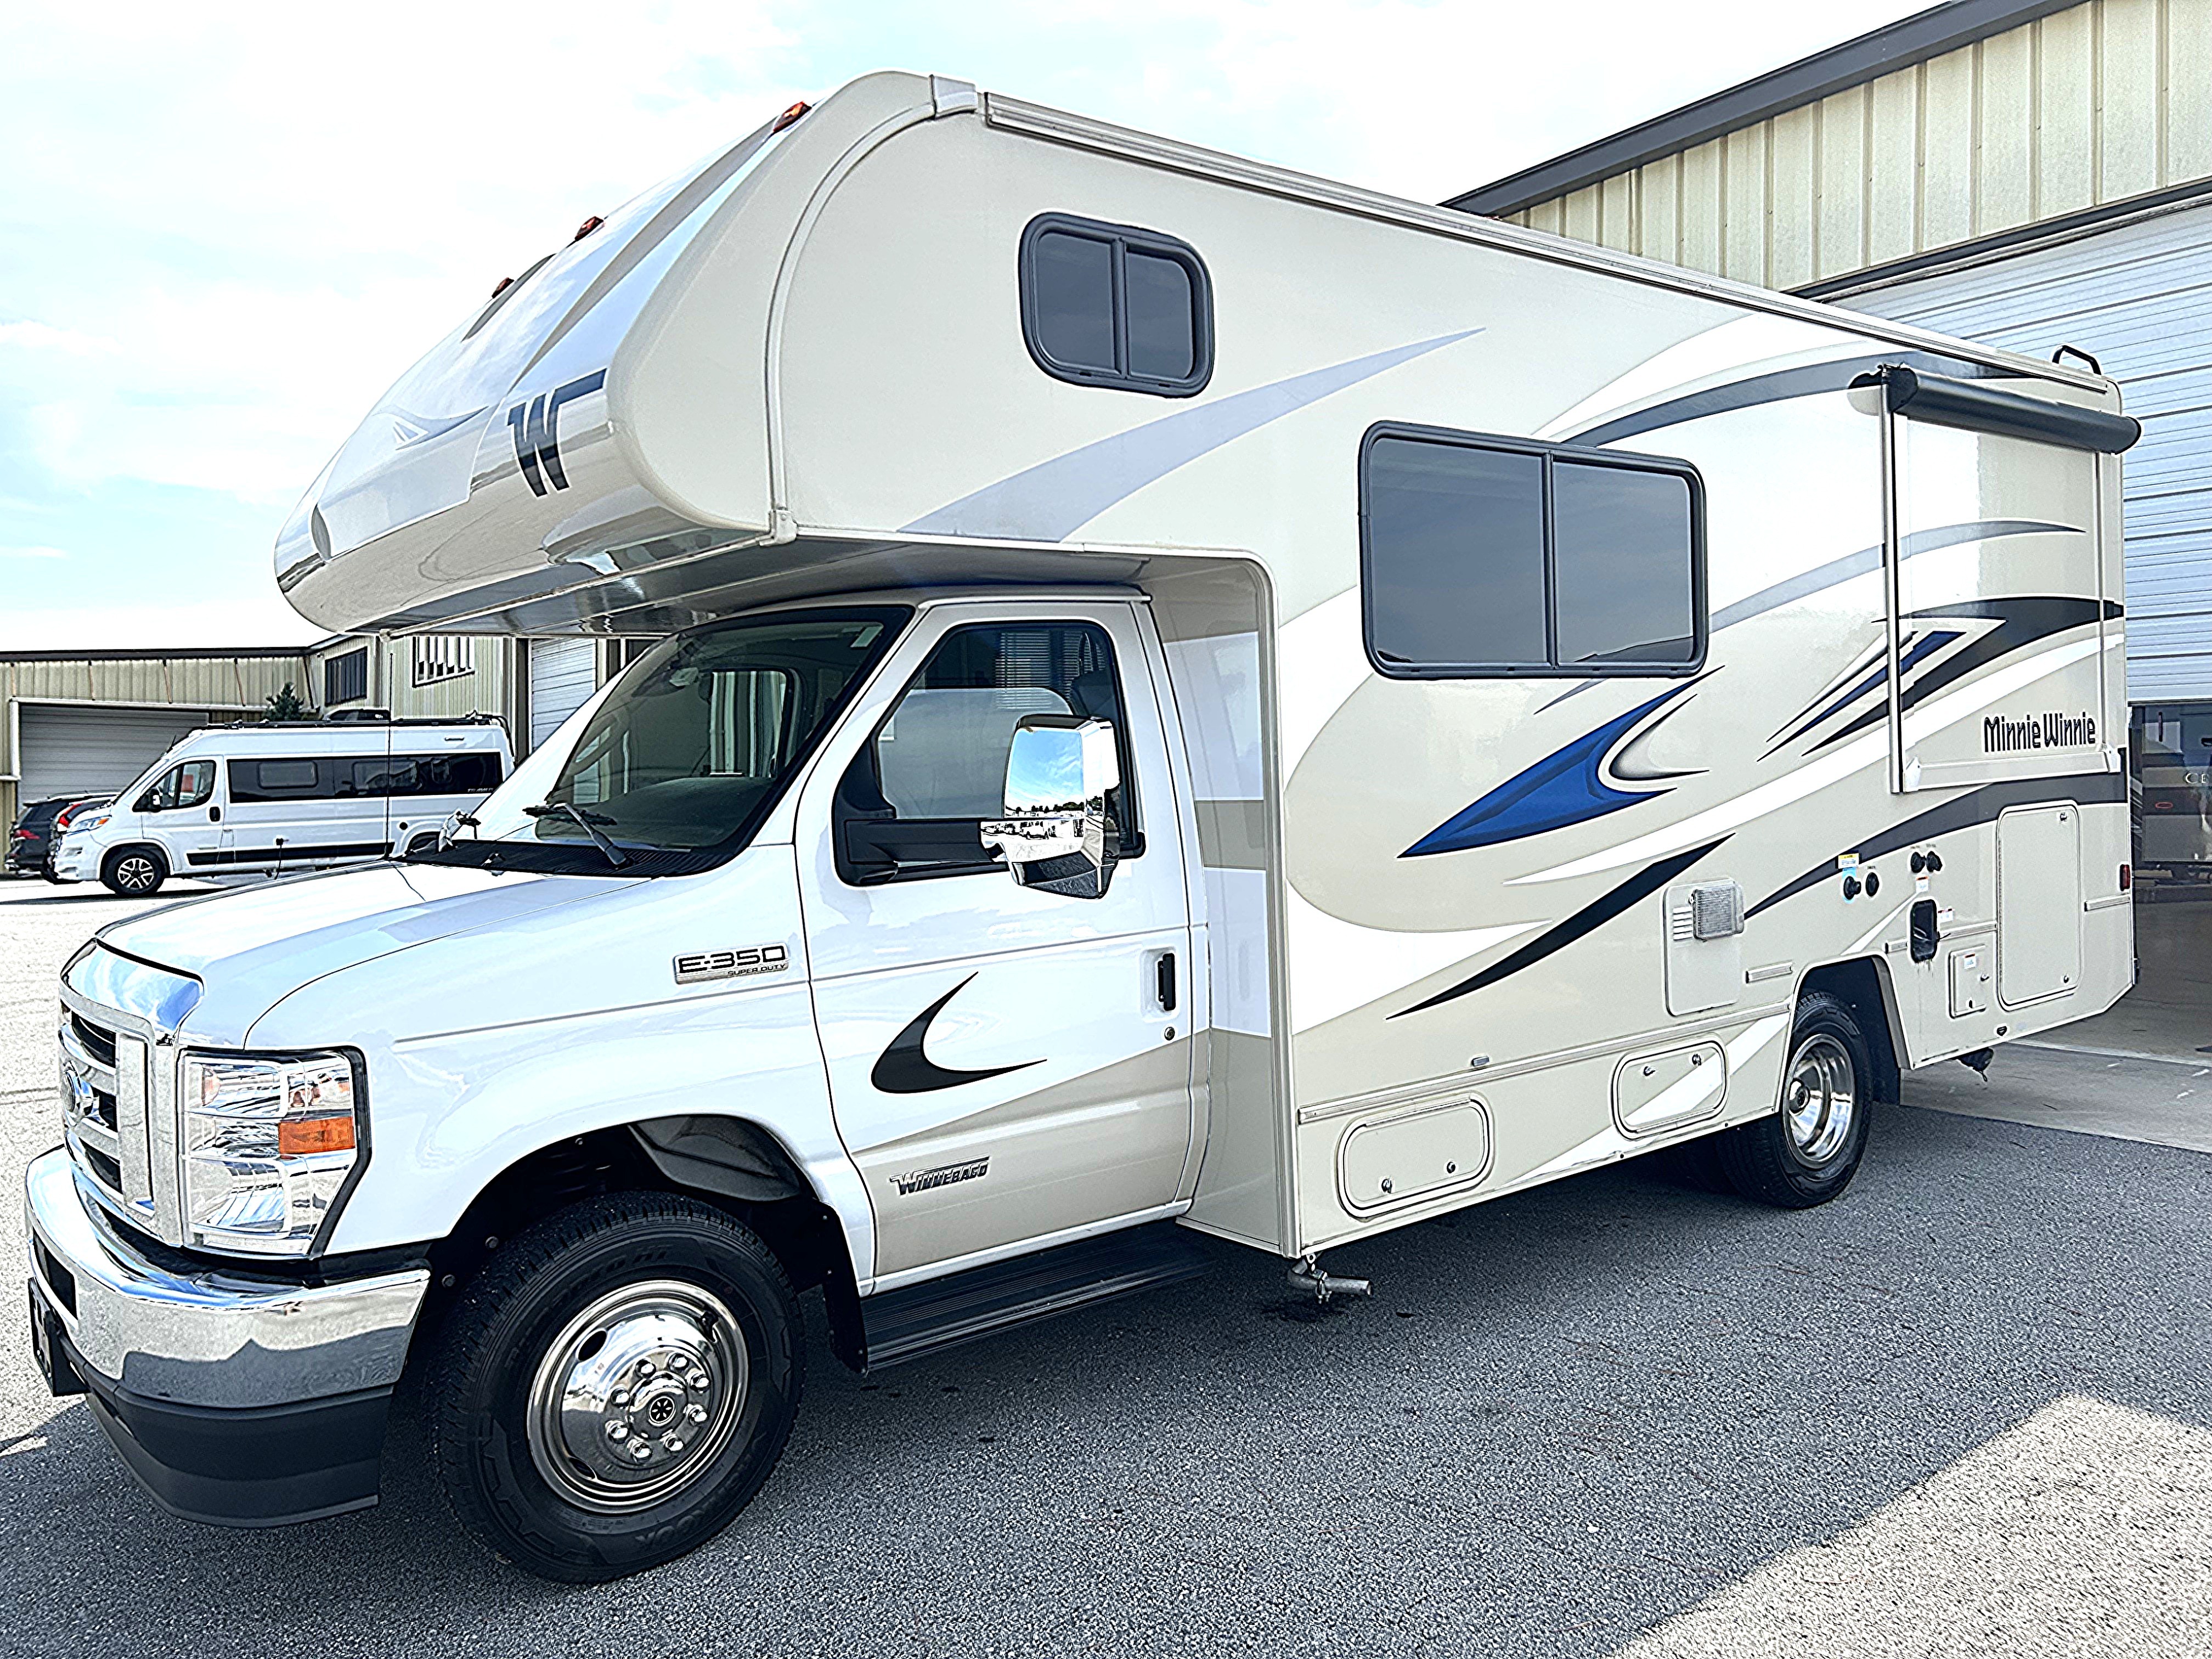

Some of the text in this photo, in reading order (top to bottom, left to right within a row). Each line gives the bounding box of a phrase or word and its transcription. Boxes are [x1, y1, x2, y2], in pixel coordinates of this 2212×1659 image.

[507, 368, 607, 497] W
[1984, 712, 2096, 752] Minnie Winnie
[678, 945, 786, 973] E-350
[727, 963, 786, 977] SUPER DUTY
[890, 1155, 990, 1195] WINNEBAGO
